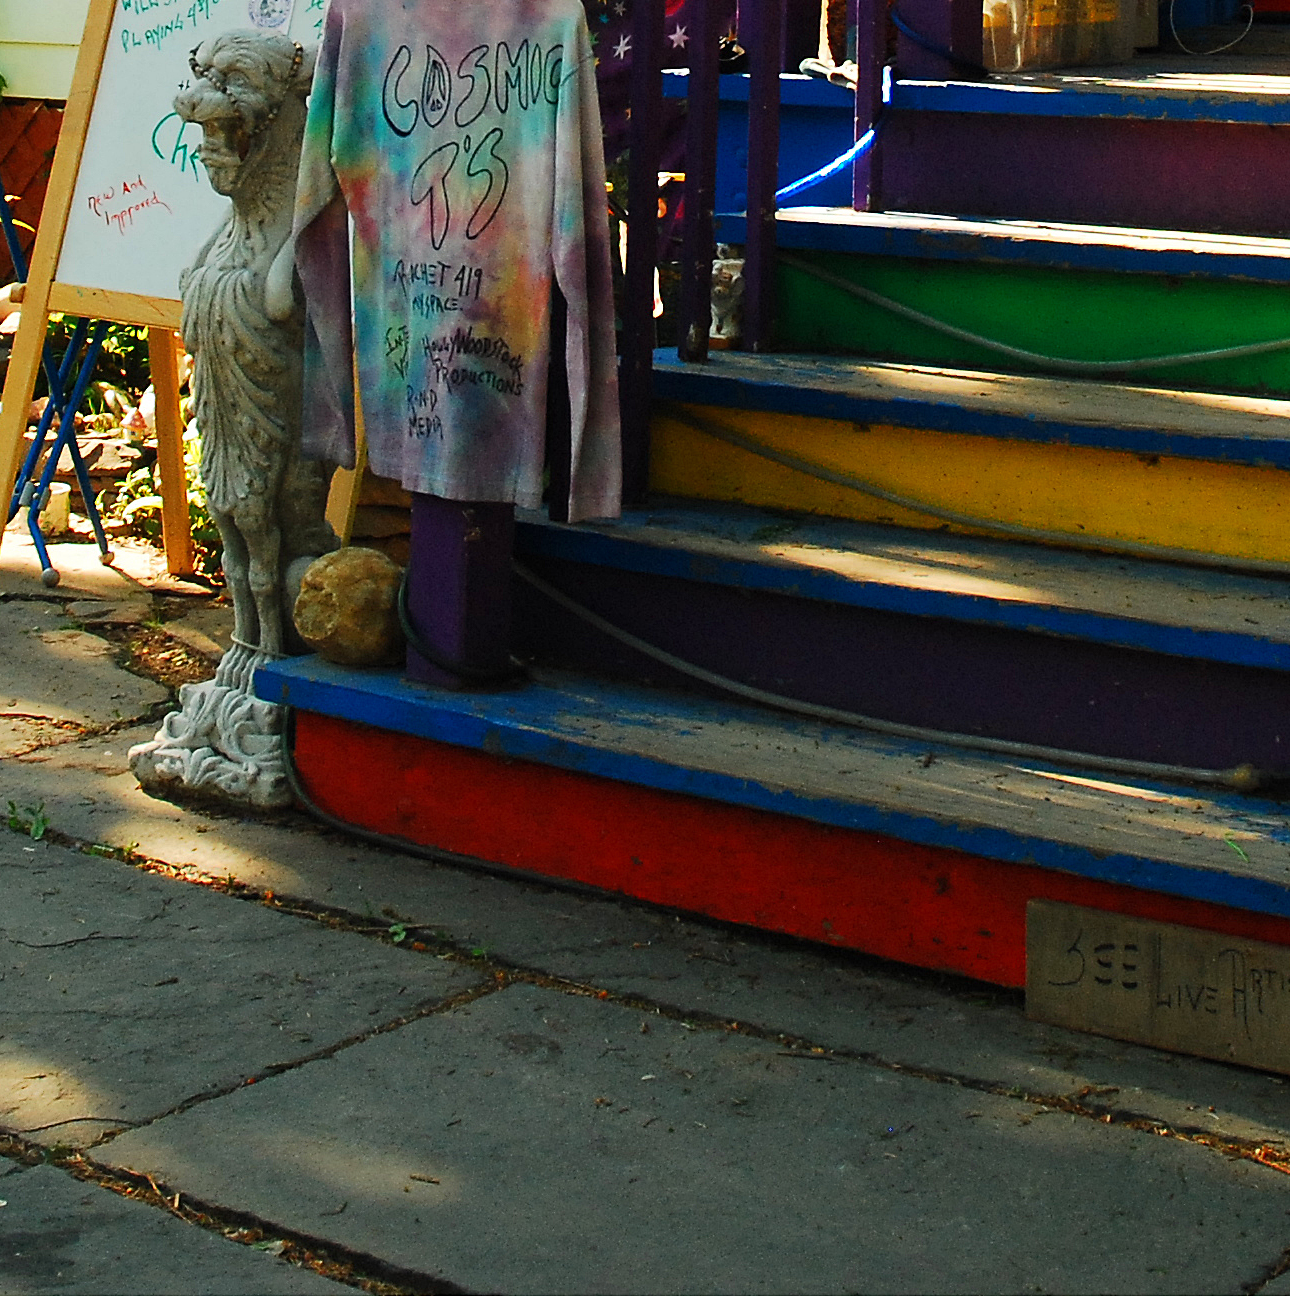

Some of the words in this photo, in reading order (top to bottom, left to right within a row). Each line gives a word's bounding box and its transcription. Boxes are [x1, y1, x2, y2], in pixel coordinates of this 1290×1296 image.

[121, 12, 184, 54] PLAYING
[382, 38, 565, 138] COSMIC
[453, 264, 484, 302] 419
[432, 358, 525, 397] PRODUCTIONS
